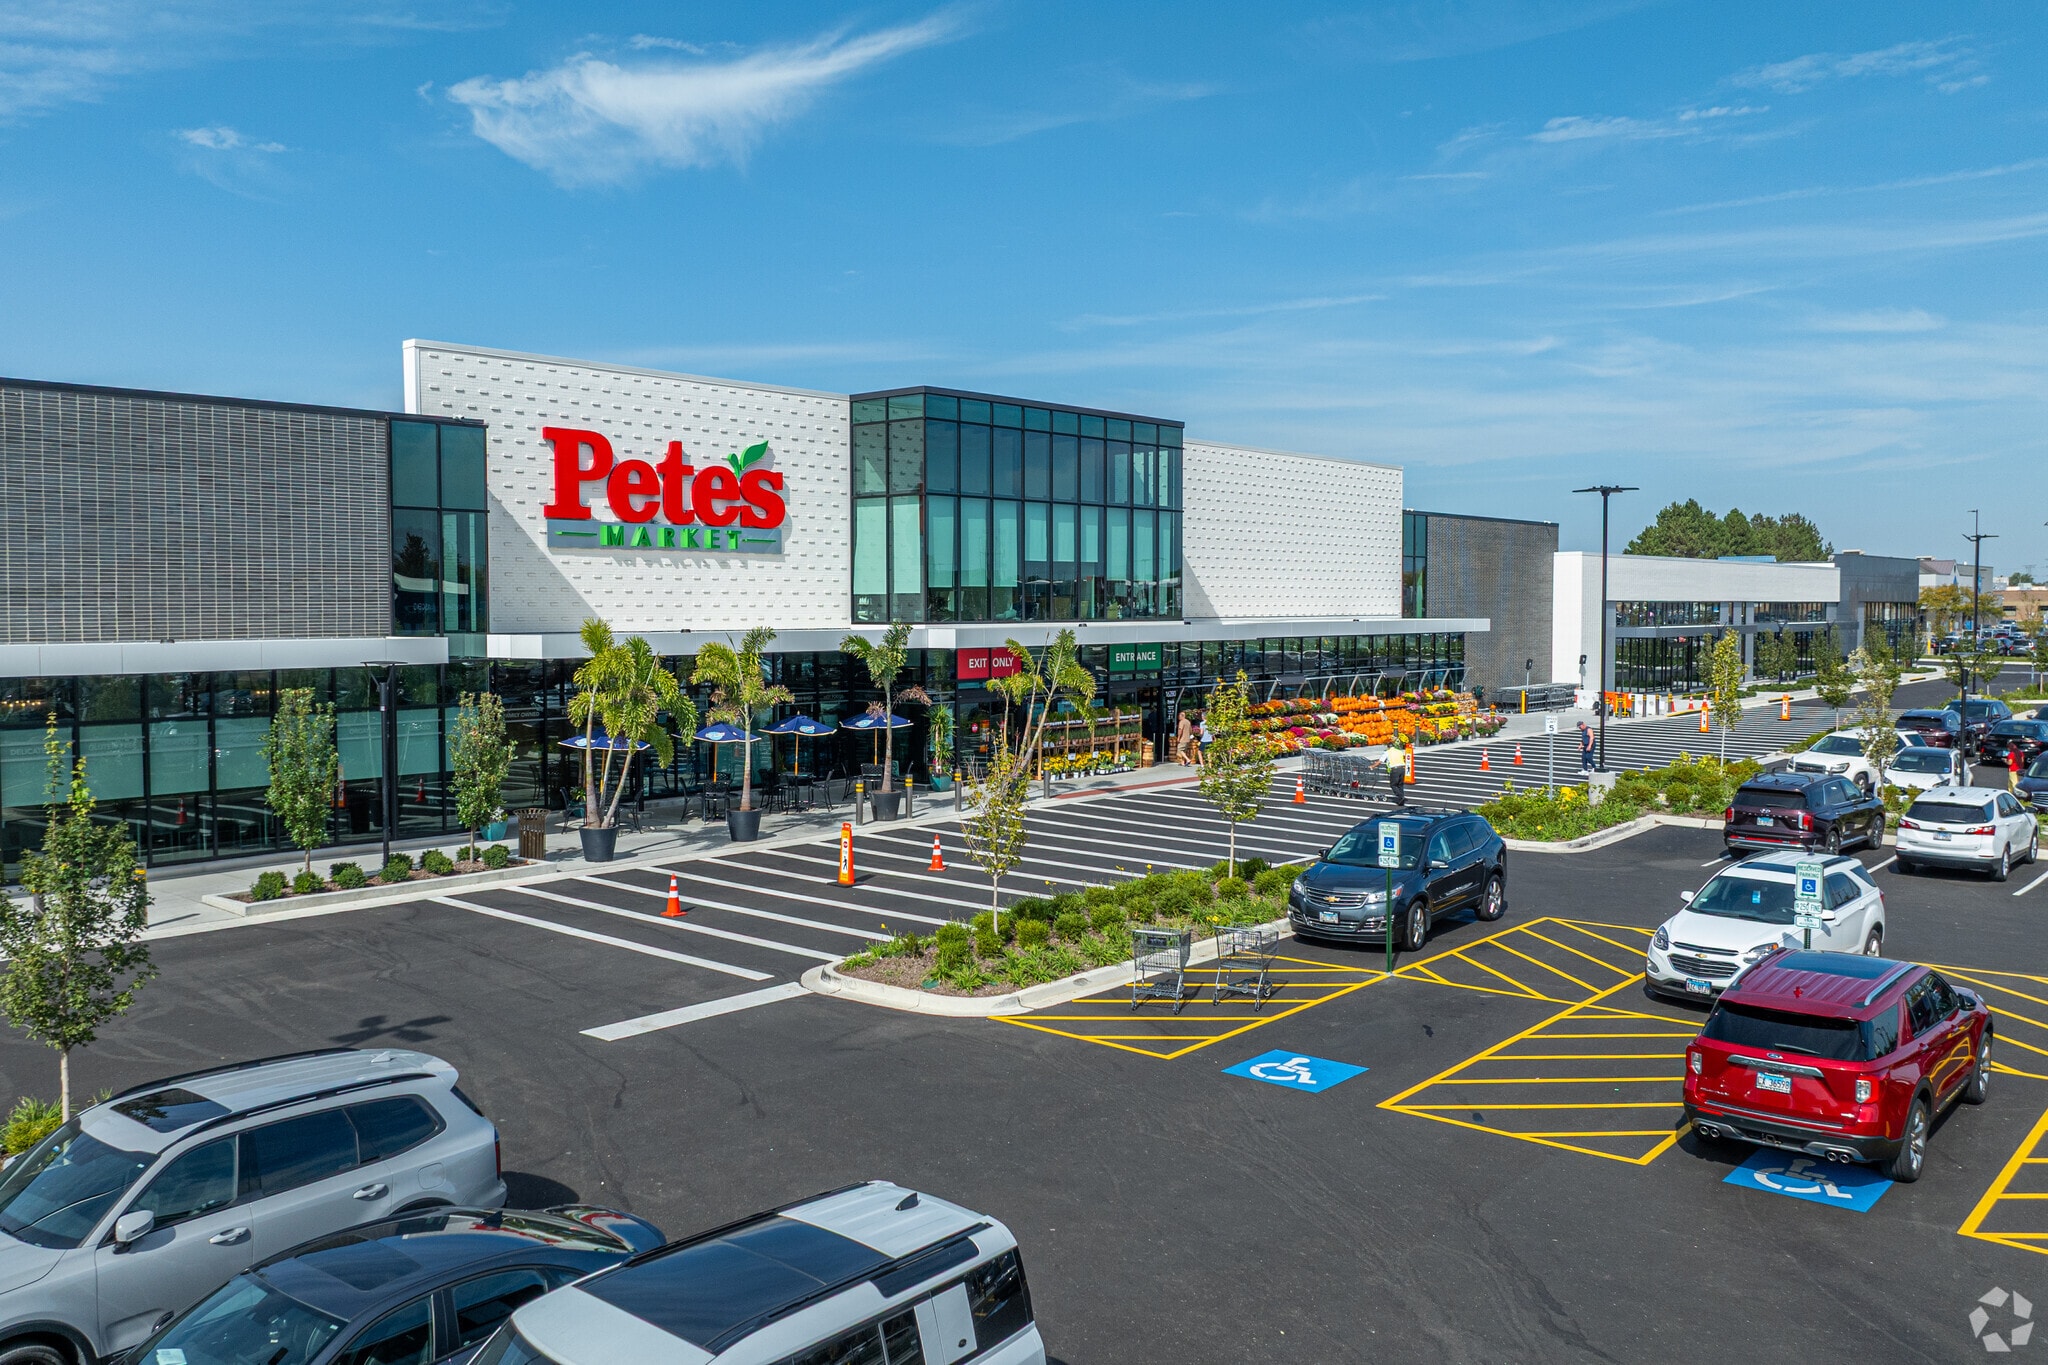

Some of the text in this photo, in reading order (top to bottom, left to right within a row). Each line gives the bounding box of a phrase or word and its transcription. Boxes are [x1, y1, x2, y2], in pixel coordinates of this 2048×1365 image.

[600, 525, 742, 550] MARKET
[1115, 651, 1157, 662] ENTRANCE
[968, 656, 1014, 669] EXIT ONLY
[1549, 724, 1555, 732] 5
[1798, 865, 1821, 873] RESERVED
[1795, 902, 1821, 912] $250 FINE
